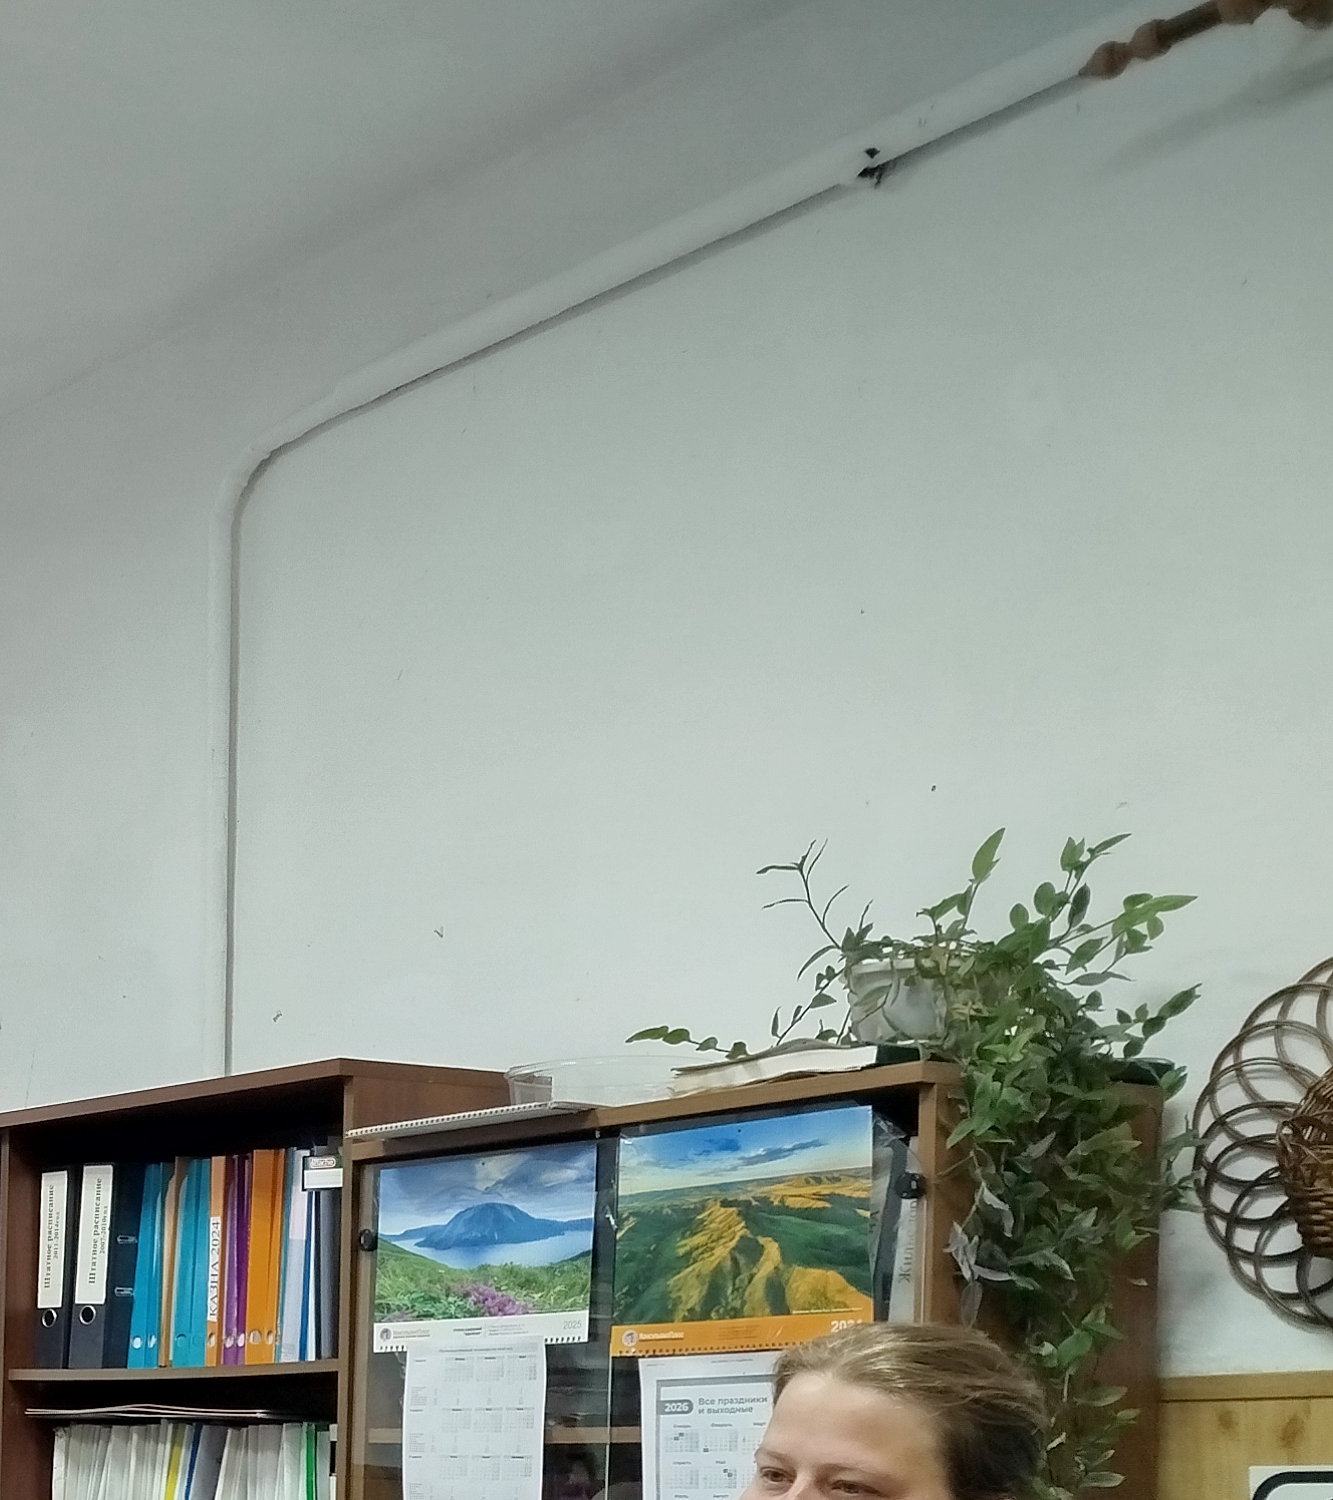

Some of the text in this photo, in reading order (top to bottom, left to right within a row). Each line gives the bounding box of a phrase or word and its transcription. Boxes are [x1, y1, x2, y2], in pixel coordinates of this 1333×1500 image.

[88, 1178, 102, 1284] Штатное расписание
[44, 1244, 52, 1288] Штатное
[209, 1221, 220, 1317] КАЗНА 2024
[562, 1319, 582, 1331] 2025
[830, 1319, 862, 1333] 202
[664, 1402, 689, 1412] 2026
[718, 1397, 768, 1406] праздники
[707, 1406, 753, 1414] выходные
